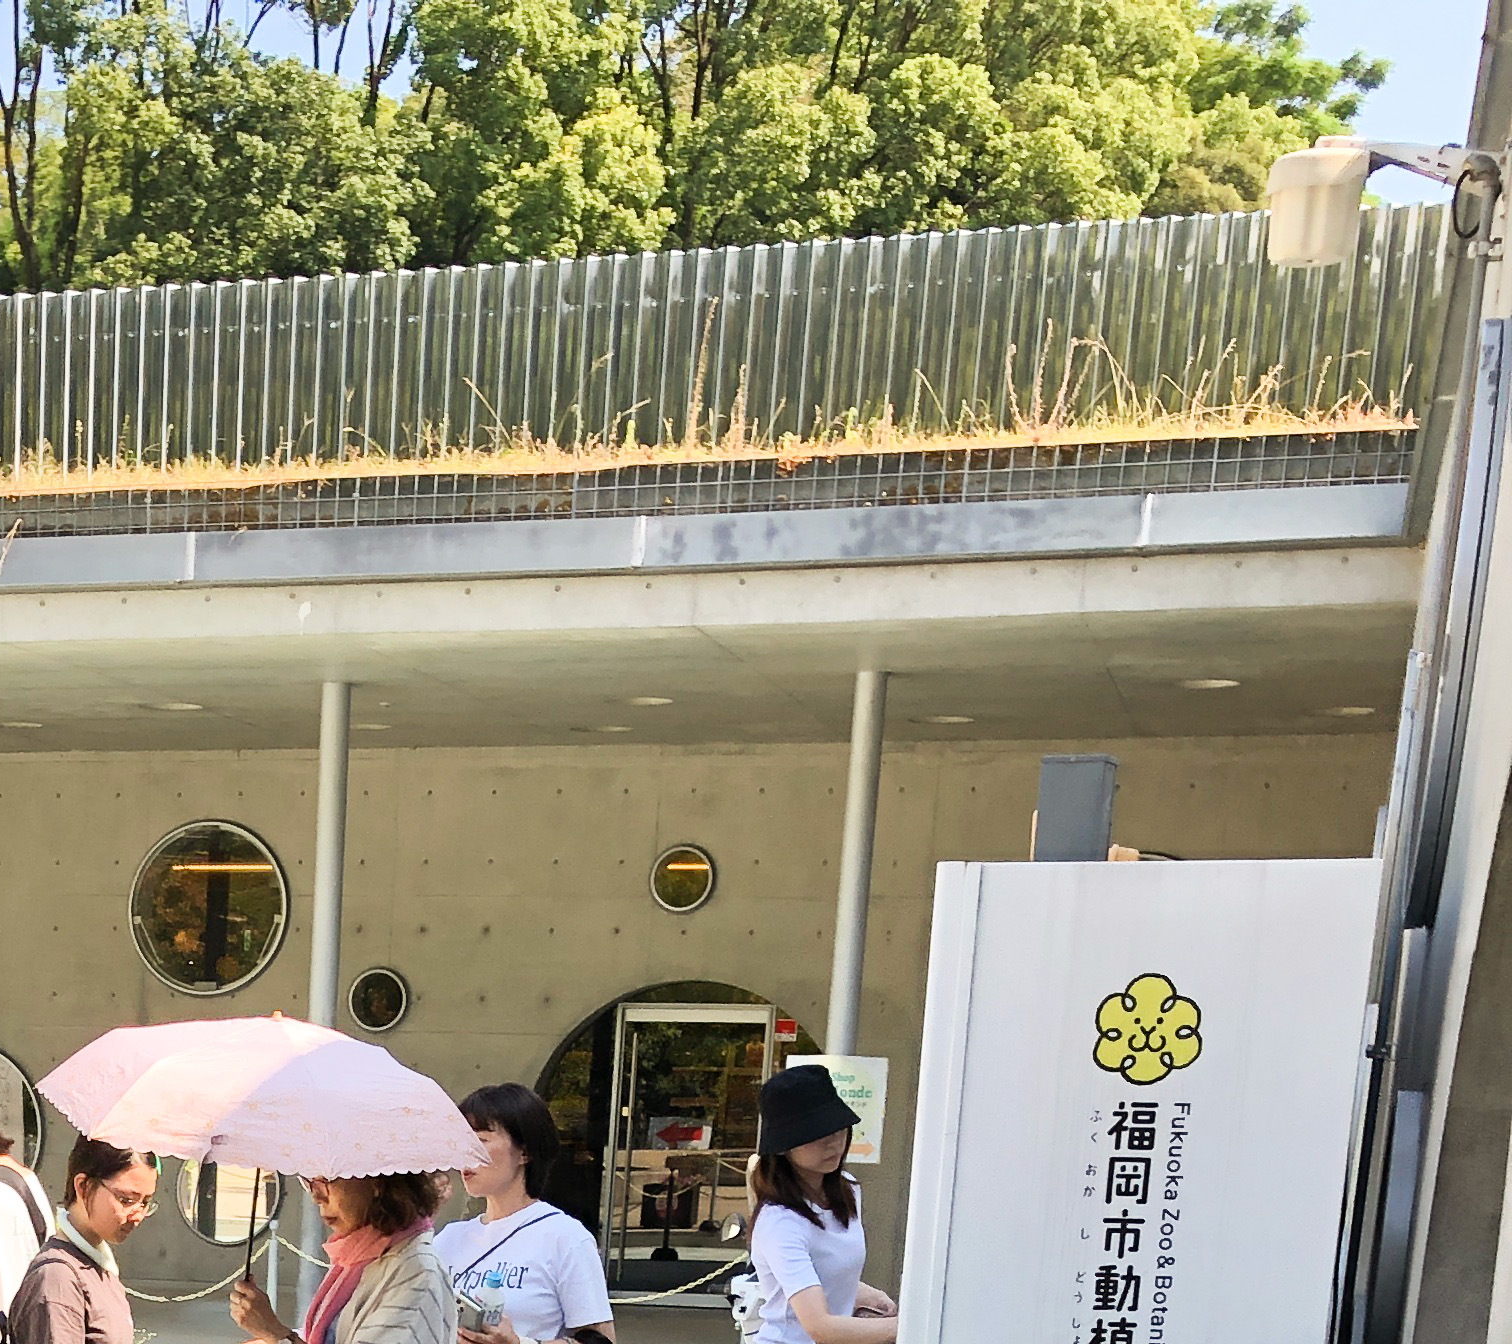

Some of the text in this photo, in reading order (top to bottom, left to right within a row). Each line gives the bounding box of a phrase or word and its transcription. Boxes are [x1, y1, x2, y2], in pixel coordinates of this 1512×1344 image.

[835, 1085, 872, 1098] onde
[1163, 1101, 1192, 1201] Fukuoka
[1158, 1209, 1181, 1251] Zoo
[1156, 1255, 1176, 1269] &
